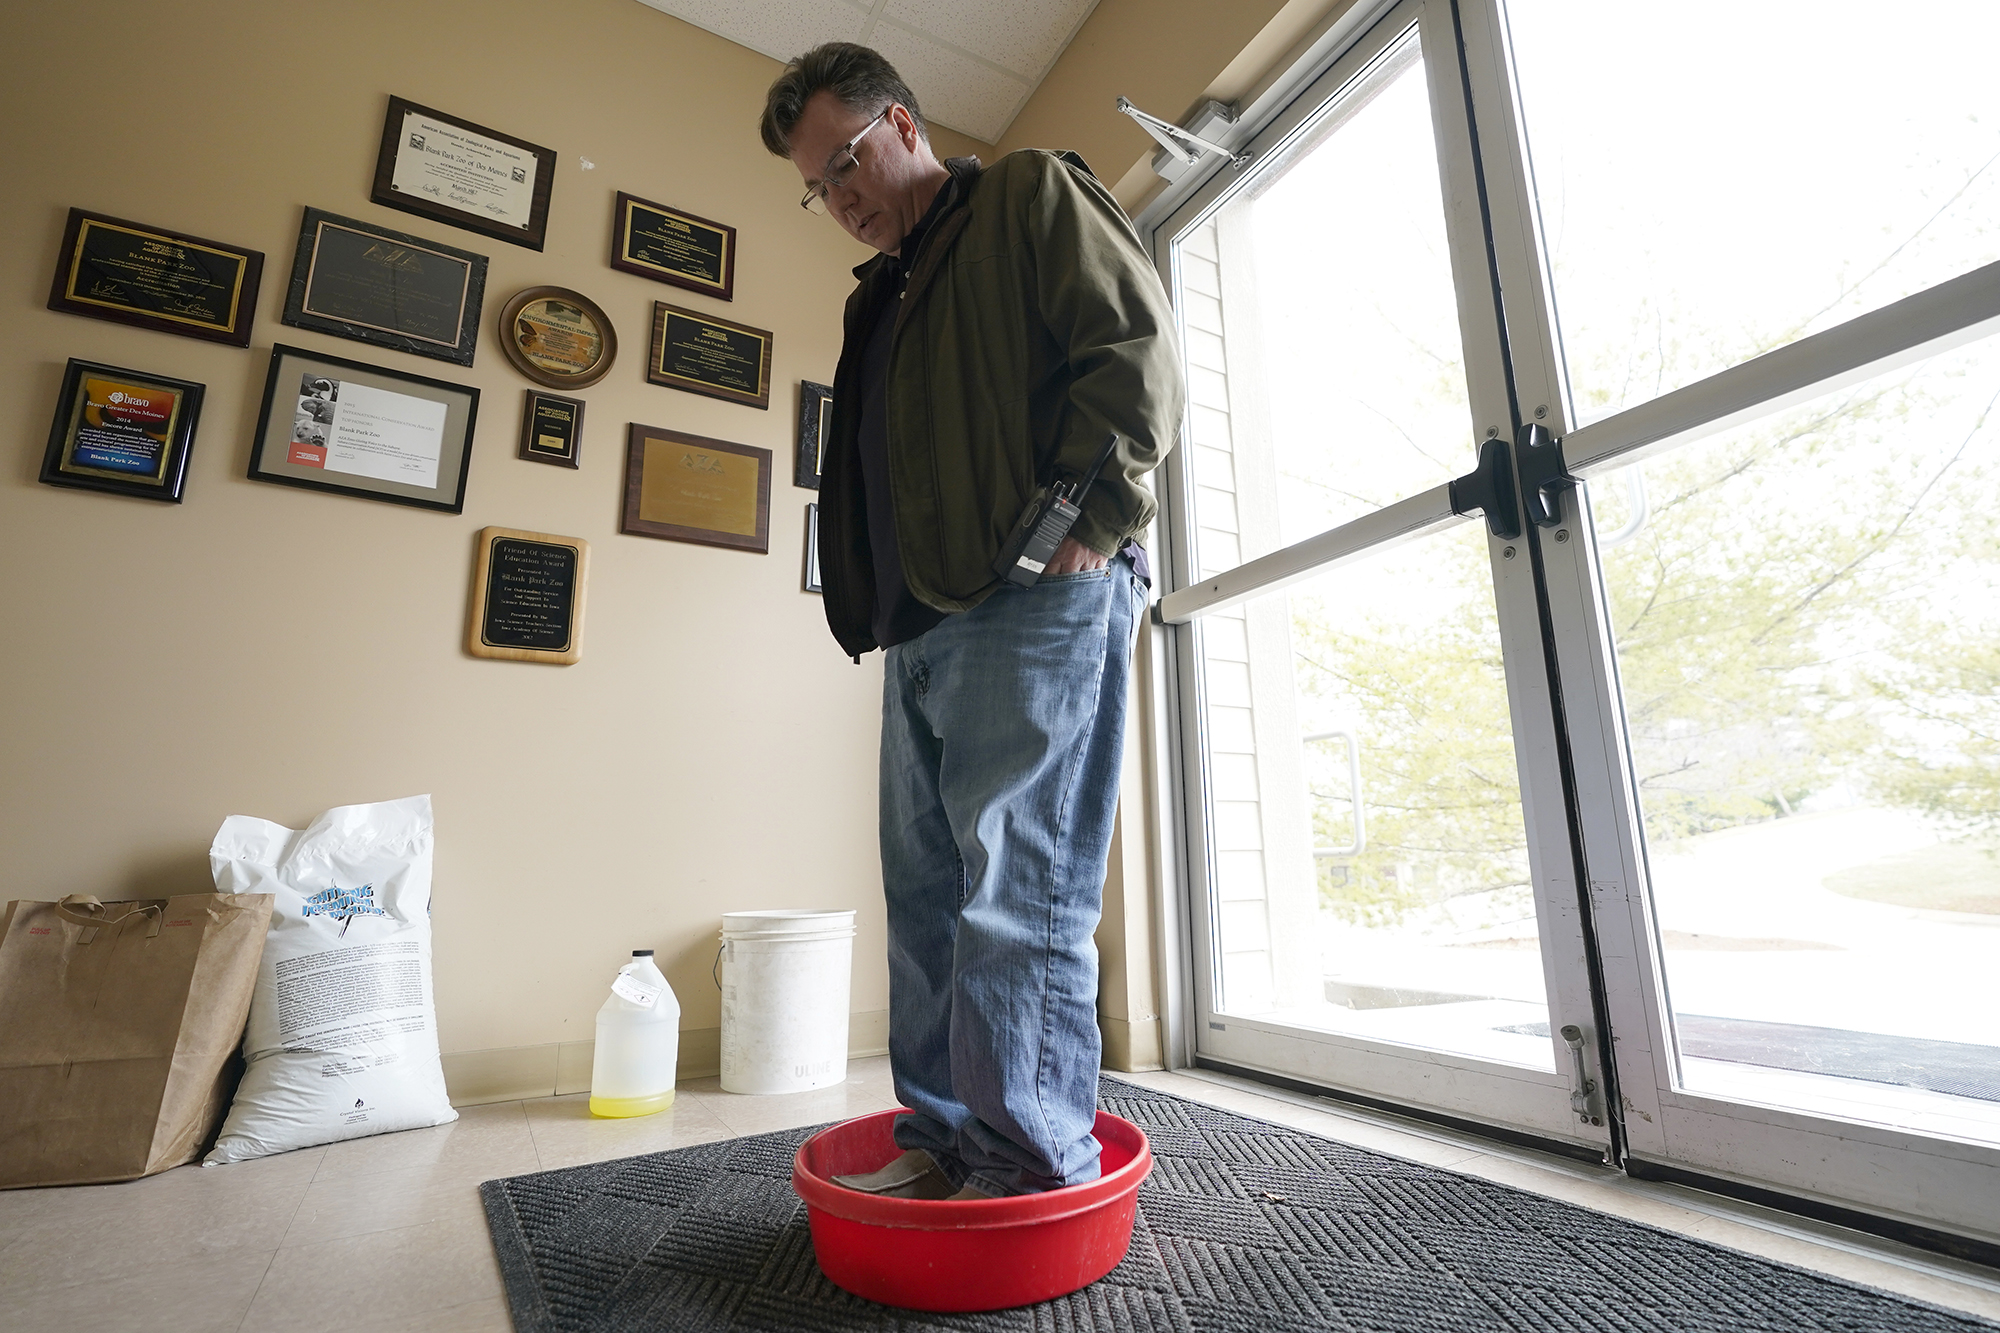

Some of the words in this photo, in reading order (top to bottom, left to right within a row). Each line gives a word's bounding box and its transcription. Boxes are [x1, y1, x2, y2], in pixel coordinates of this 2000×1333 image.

[422, 124, 438, 133] American
[440, 130, 459, 140] Association
[466, 139, 483, 149] Zoological
[504, 152, 520, 161] Aquariums
[426, 146, 441, 156] Blank
[442, 151, 454, 161] Park
[456, 156, 466, 165] Zoo
[468, 159, 475, 167] of
[477, 162, 486, 171] Des
[488, 166, 508, 178] Moines
[452, 184, 467, 194] March
[129, 252, 155, 263] BLANK
[157, 259, 177, 268] PARK
[179, 263, 196, 272] ZOO
[137, 276, 180, 290] Accreditation
[522, 314, 575, 332] ENVIRONMENTAL
[577, 329, 599, 339] IMPACT
[548, 327, 573, 337] AWARDS
[533, 352, 554, 361] BLANK
[124, 393, 149, 408] bravo
[105, 404, 128, 412] Greater
[142, 411, 164, 419] Moines
[343, 409, 381, 421] INTERNATIONAL
[382, 417, 416, 428] CONSERVATION
[352, 419, 373, 427] HONORS
[102, 422, 122, 430] Encore
[123, 425, 143, 433] Award
[113, 433, 138, 441] organization
[114, 442, 142, 451] programming
[91, 454, 110, 462] Blank
[1059, 506, 1078, 517] MOTOROLA
[504, 546, 526, 555] Friend
[542, 552, 567, 560] Science
[505, 555, 539, 565] Education
[543, 560, 565, 568] Award
[502, 573, 525, 583] Blank
[529, 577, 547, 586] Park
[550, 579, 564, 587] Zoo
[514, 588, 541, 596] Outstanding
[794, 1059, 831, 1078] ULINE
